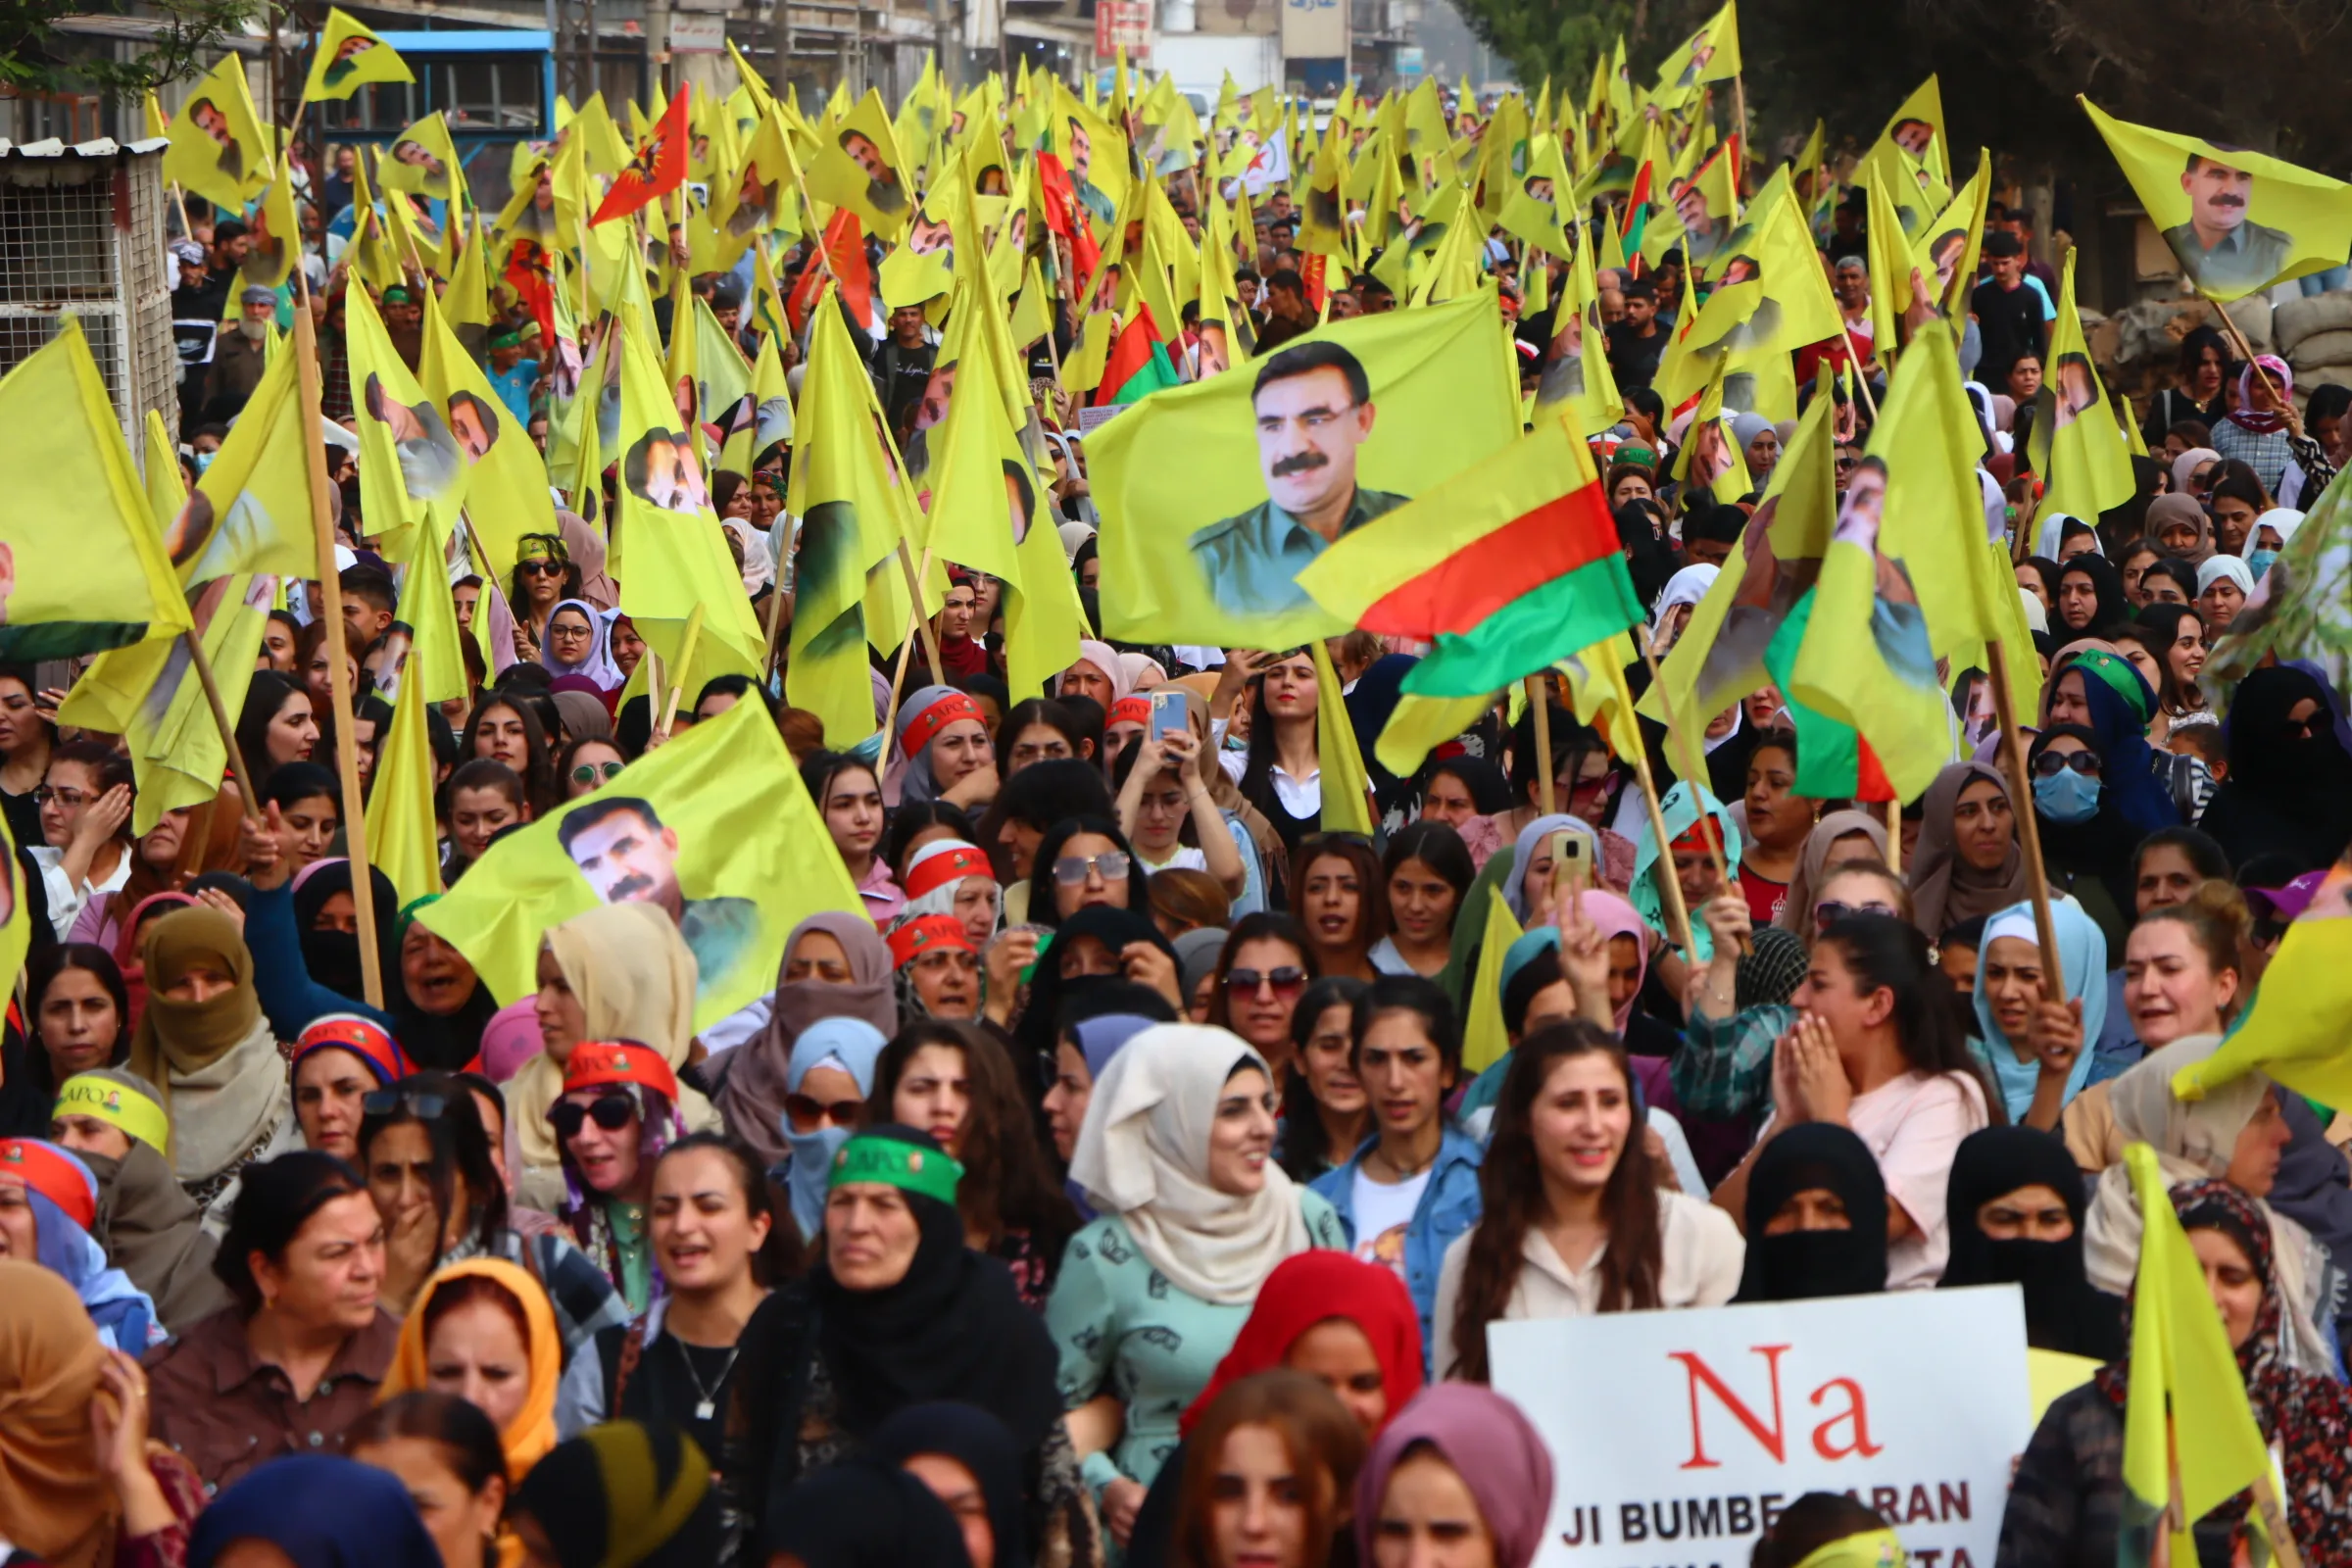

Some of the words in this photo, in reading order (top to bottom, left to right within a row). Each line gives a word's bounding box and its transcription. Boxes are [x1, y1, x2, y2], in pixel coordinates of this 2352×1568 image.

[938, 701, 964, 716] APO
[1121, 703, 1149, 715] APO
[575, 1055, 613, 1074] APO
[66, 1086, 105, 1103] APO
[1667, 1344, 1884, 1469] Na
[1562, 1504, 1601, 1546] JI
